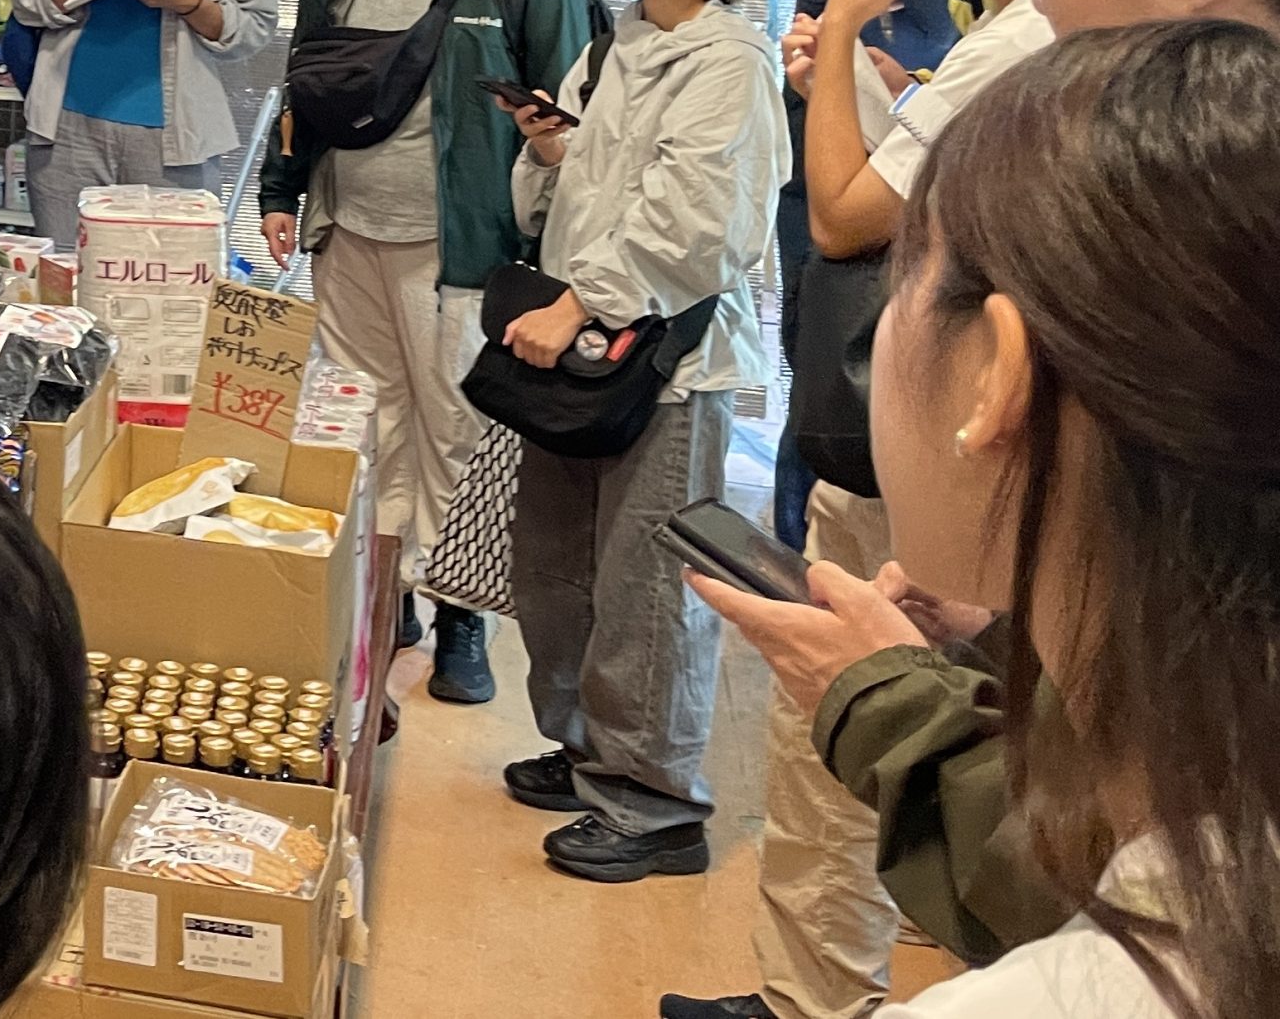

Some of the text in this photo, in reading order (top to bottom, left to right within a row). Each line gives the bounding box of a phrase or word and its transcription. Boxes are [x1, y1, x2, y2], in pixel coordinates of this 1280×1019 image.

[95, 260, 214, 285] エルロール
[223, 317, 257, 337] しお
[206, 336, 304, 382] ポテトチップス
